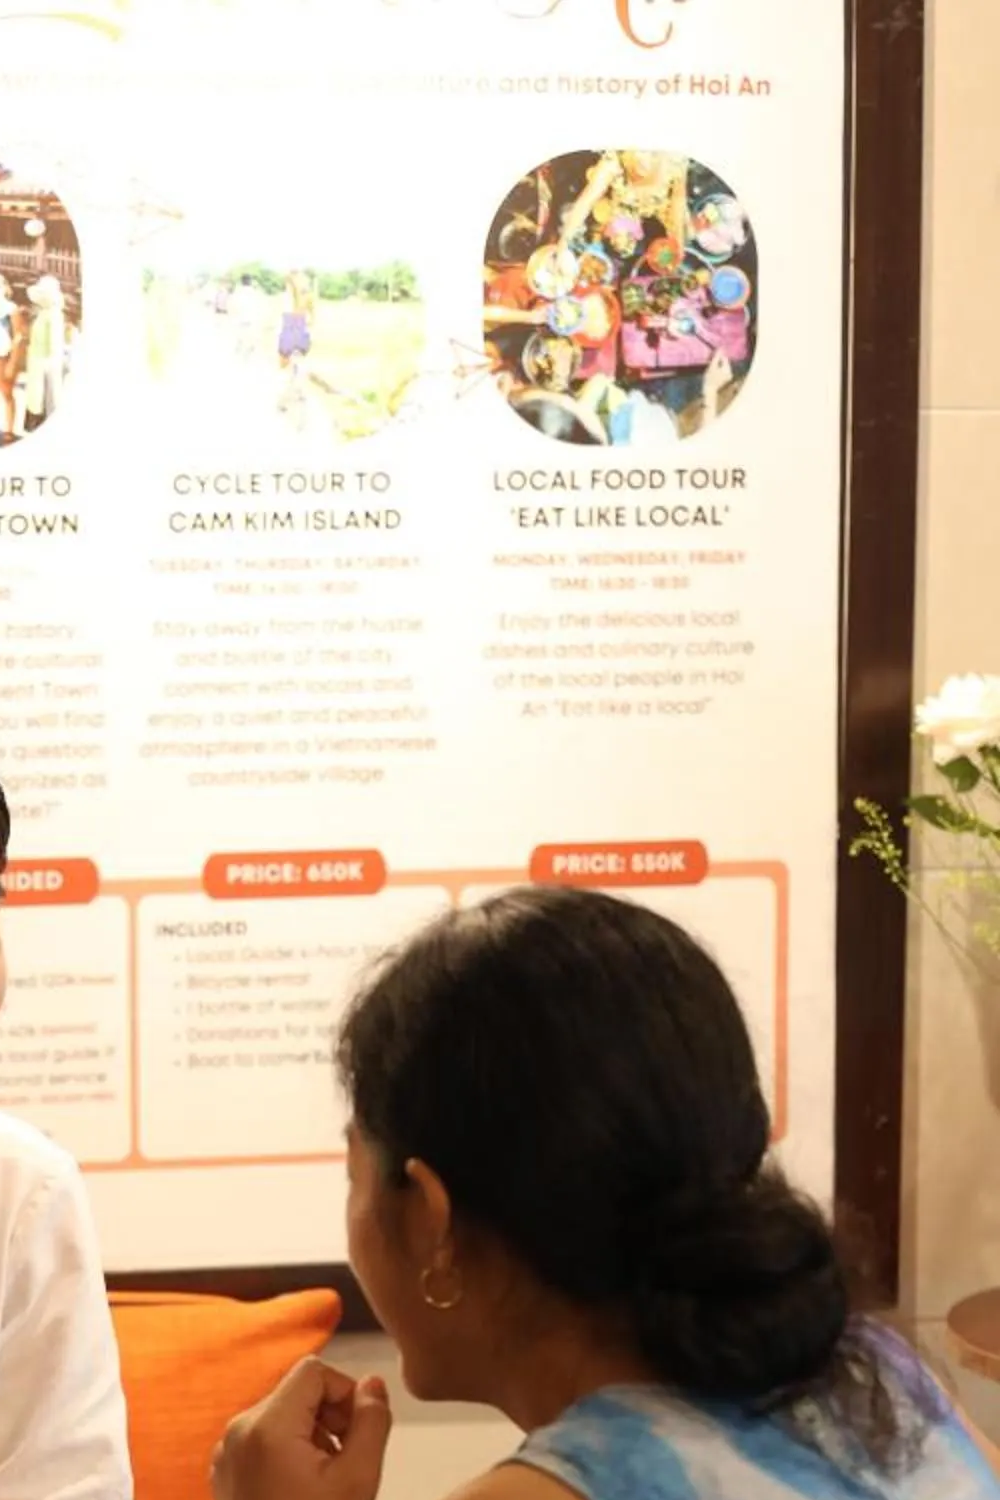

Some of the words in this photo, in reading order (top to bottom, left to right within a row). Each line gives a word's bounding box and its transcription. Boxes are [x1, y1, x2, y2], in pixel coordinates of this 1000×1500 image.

[499, 74, 548, 95] and
[557, 71, 647, 99] history
[654, 72, 683, 95] of
[689, 73, 730, 97] Hoi
[737, 74, 772, 97] An
[34, 475, 72, 498] TO
[172, 473, 262, 496] CYCLE
[271, 472, 345, 495] TOUR
[355, 471, 392, 494] TO
[493, 469, 582, 492] LOCAL
[590, 468, 667, 491] FOOD
[673, 467, 748, 490] TOUR
[168, 510, 234, 534] CAM
[244, 509, 295, 532] KIM
[304, 508, 402, 531] ISLAND
[574, 505, 627, 528] LIKE
[226, 863, 302, 886] PRICE:
[306, 861, 365, 882] 650K
[552, 853, 626, 875] PRICE:
[155, 921, 248, 938] INCLUDED
